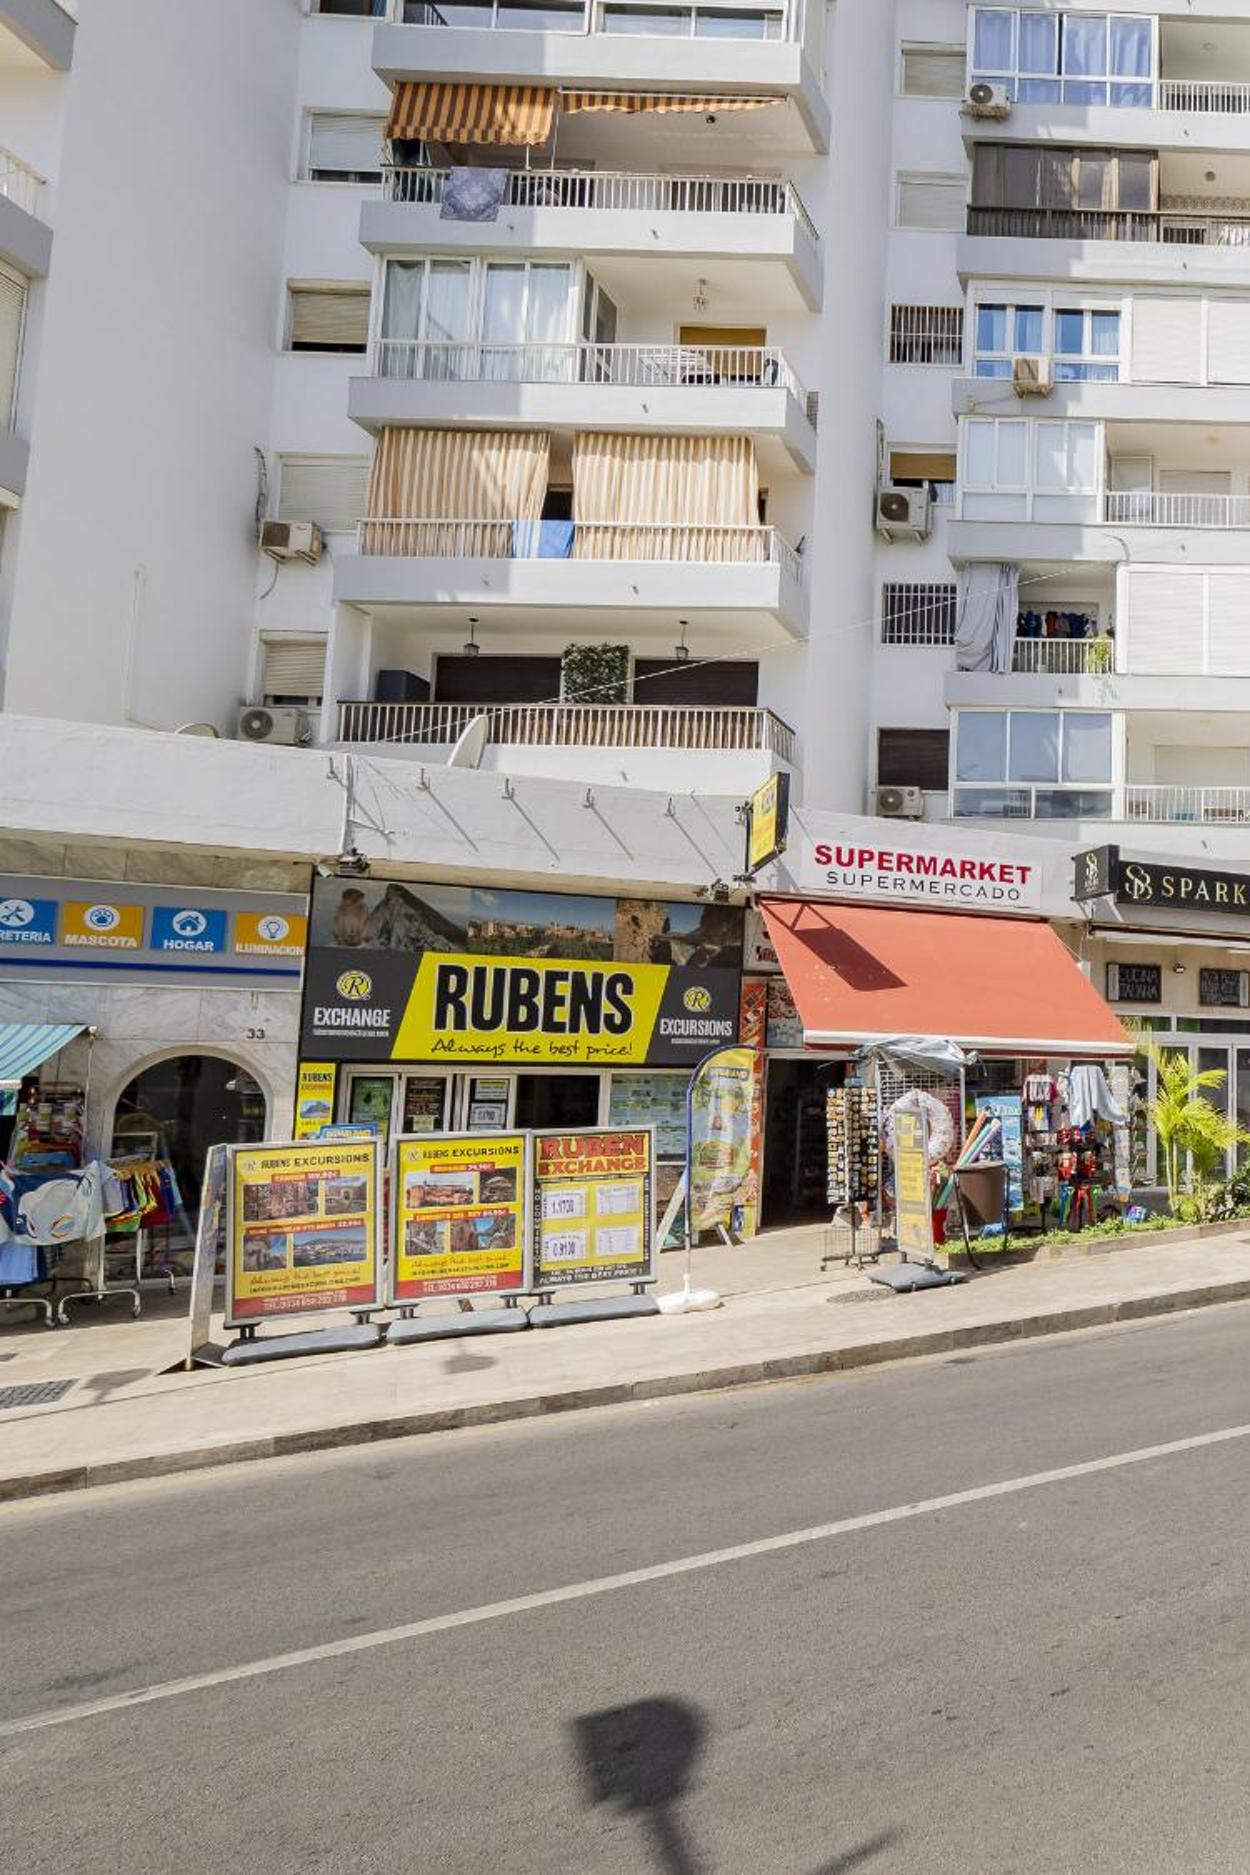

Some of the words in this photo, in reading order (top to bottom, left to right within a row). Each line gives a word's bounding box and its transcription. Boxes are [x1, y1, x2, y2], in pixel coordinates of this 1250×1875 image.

[814, 844, 1032, 885] SUPERMARKET
[826, 870, 1021, 901] SUPERMERCADO
[1161, 875, 1247, 904] SPARK
[64, 934, 138, 948] MASCOTA
[163, 939, 214, 952] HOGAR
[434, 963, 635, 1035] RUBENS
[313, 1007, 391, 1027] EXCHANGE
[660, 1018, 732, 1036] EXCURSIONS
[246, 1028, 266, 1040] 33
[431, 1039, 505, 1057] Always
[512, 1038, 541, 1055] the
[550, 1039, 580, 1055] best
[587, 1042, 633, 1060] price!
[452, 1146, 519, 1158] EXCURSIONS
[540, 1135, 645, 1161] RUBEN
[294, 1153, 370, 1168] EXCURSIONS
[538, 1156, 646, 1176] EXCHANGE
